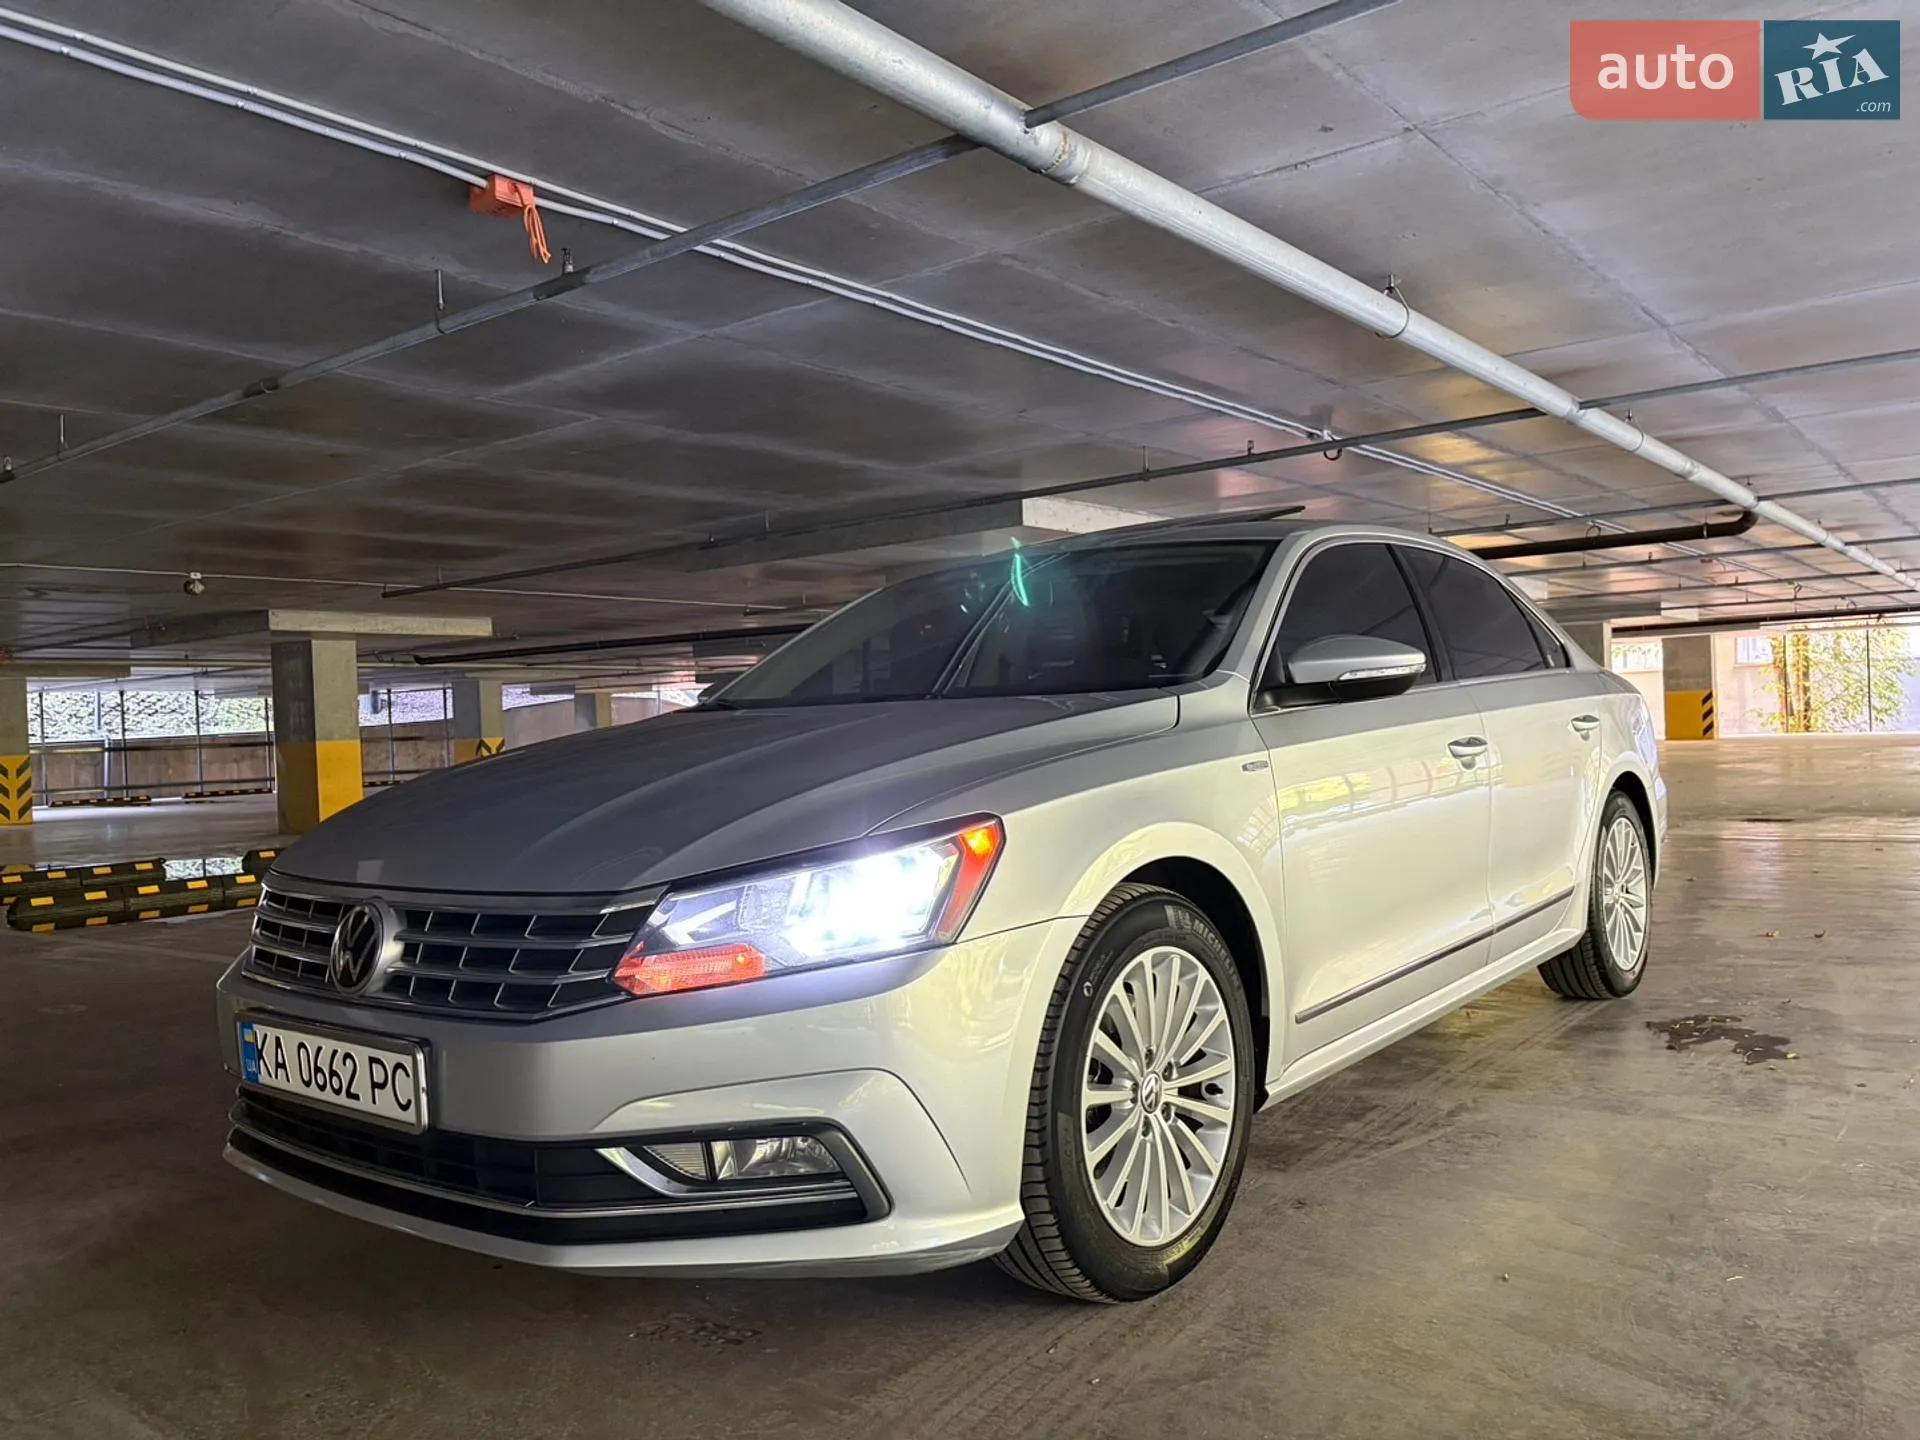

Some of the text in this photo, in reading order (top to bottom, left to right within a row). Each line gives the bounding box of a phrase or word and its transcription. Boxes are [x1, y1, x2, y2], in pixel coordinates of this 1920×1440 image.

[255, 1031, 412, 1112] KA 0662 PC
